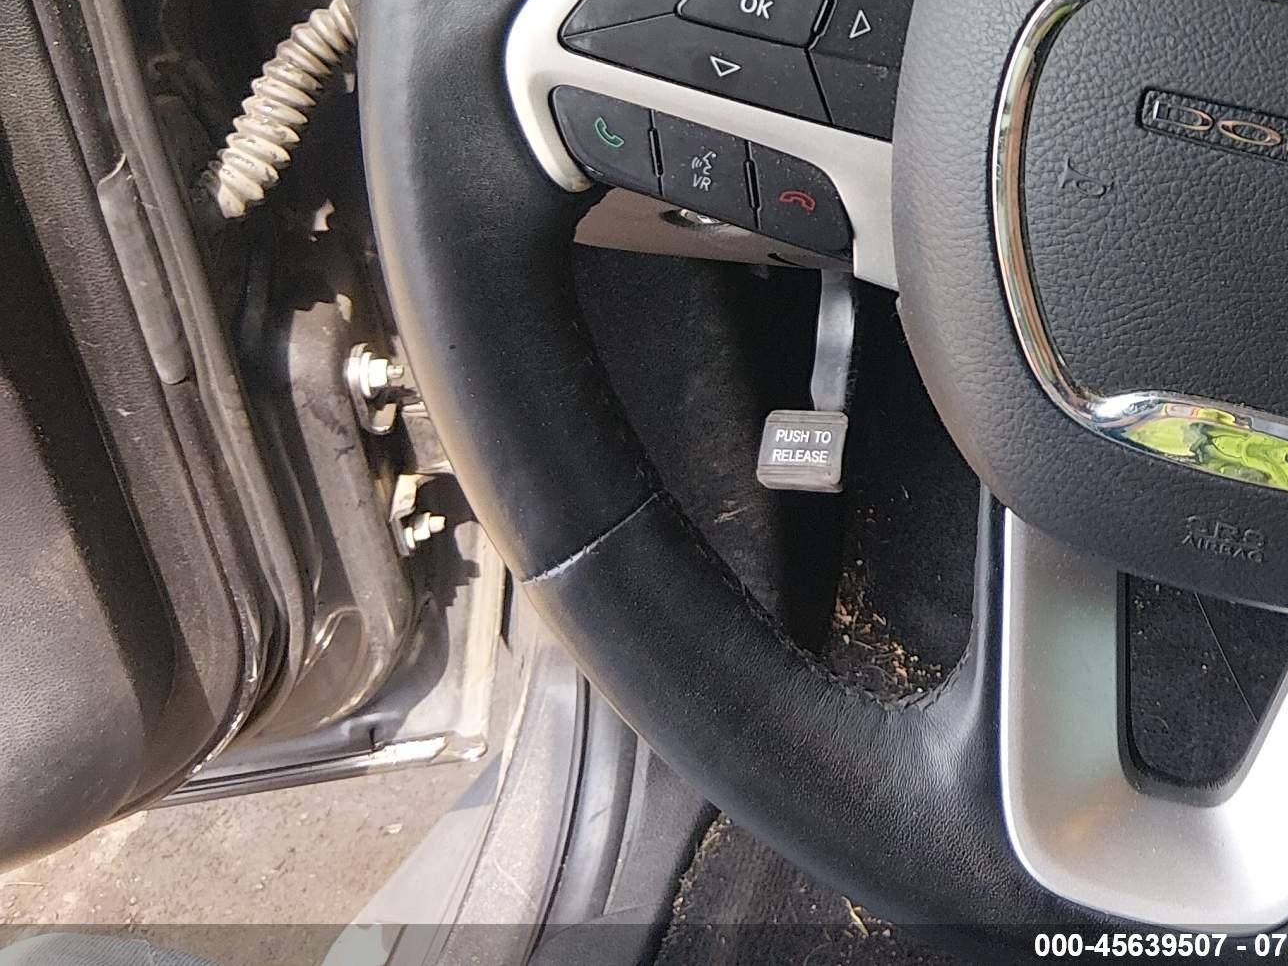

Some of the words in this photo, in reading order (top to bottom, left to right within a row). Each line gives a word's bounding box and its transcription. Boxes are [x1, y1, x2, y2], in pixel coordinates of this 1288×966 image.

[693, 173, 712, 191] VR
[775, 429, 810, 443] PUSH
[815, 430, 832, 444] TO
[772, 448, 829, 463] RELEASE
[1182, 533, 1263, 563] AIRBAG
